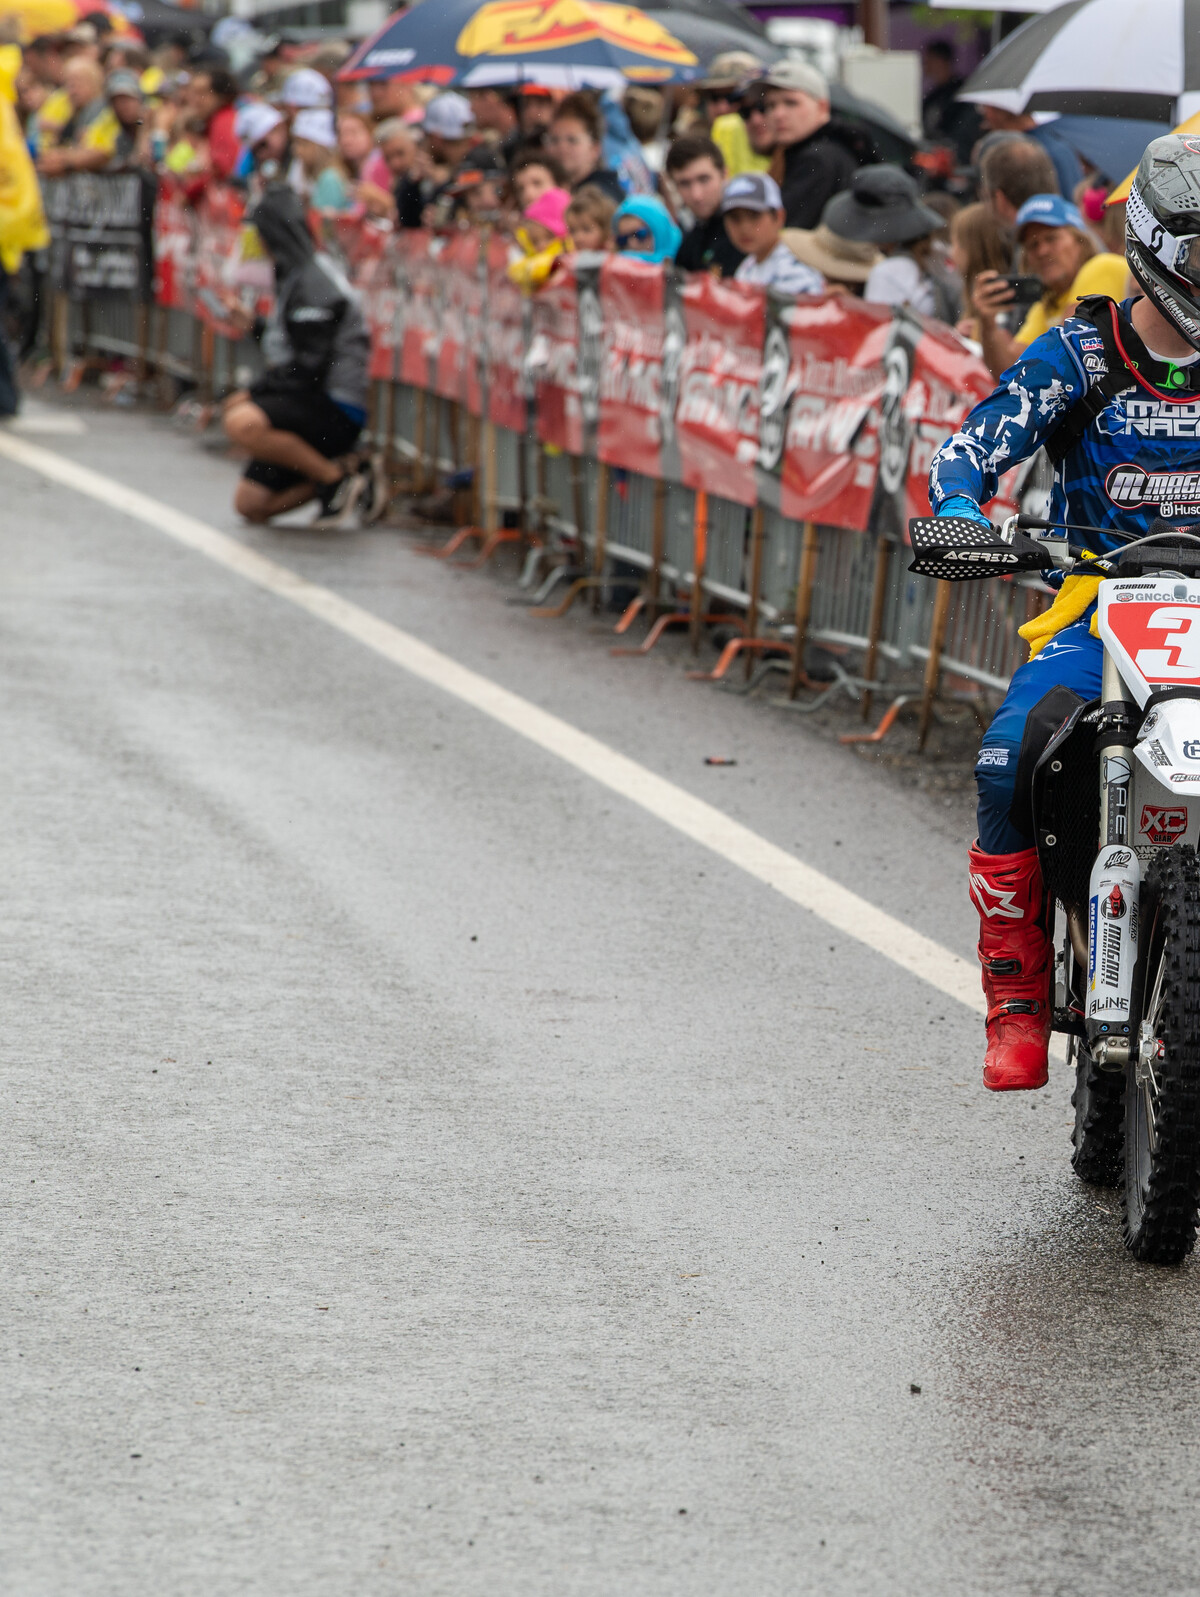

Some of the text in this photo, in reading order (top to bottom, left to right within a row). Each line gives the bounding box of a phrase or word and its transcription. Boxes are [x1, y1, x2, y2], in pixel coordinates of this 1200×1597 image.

[942, 550, 1019, 564] ACERBIS
[1113, 583, 1157, 591] ASHBURN
[1142, 811, 1187, 833] XC
[1153, 833, 1172, 842] GEAR
